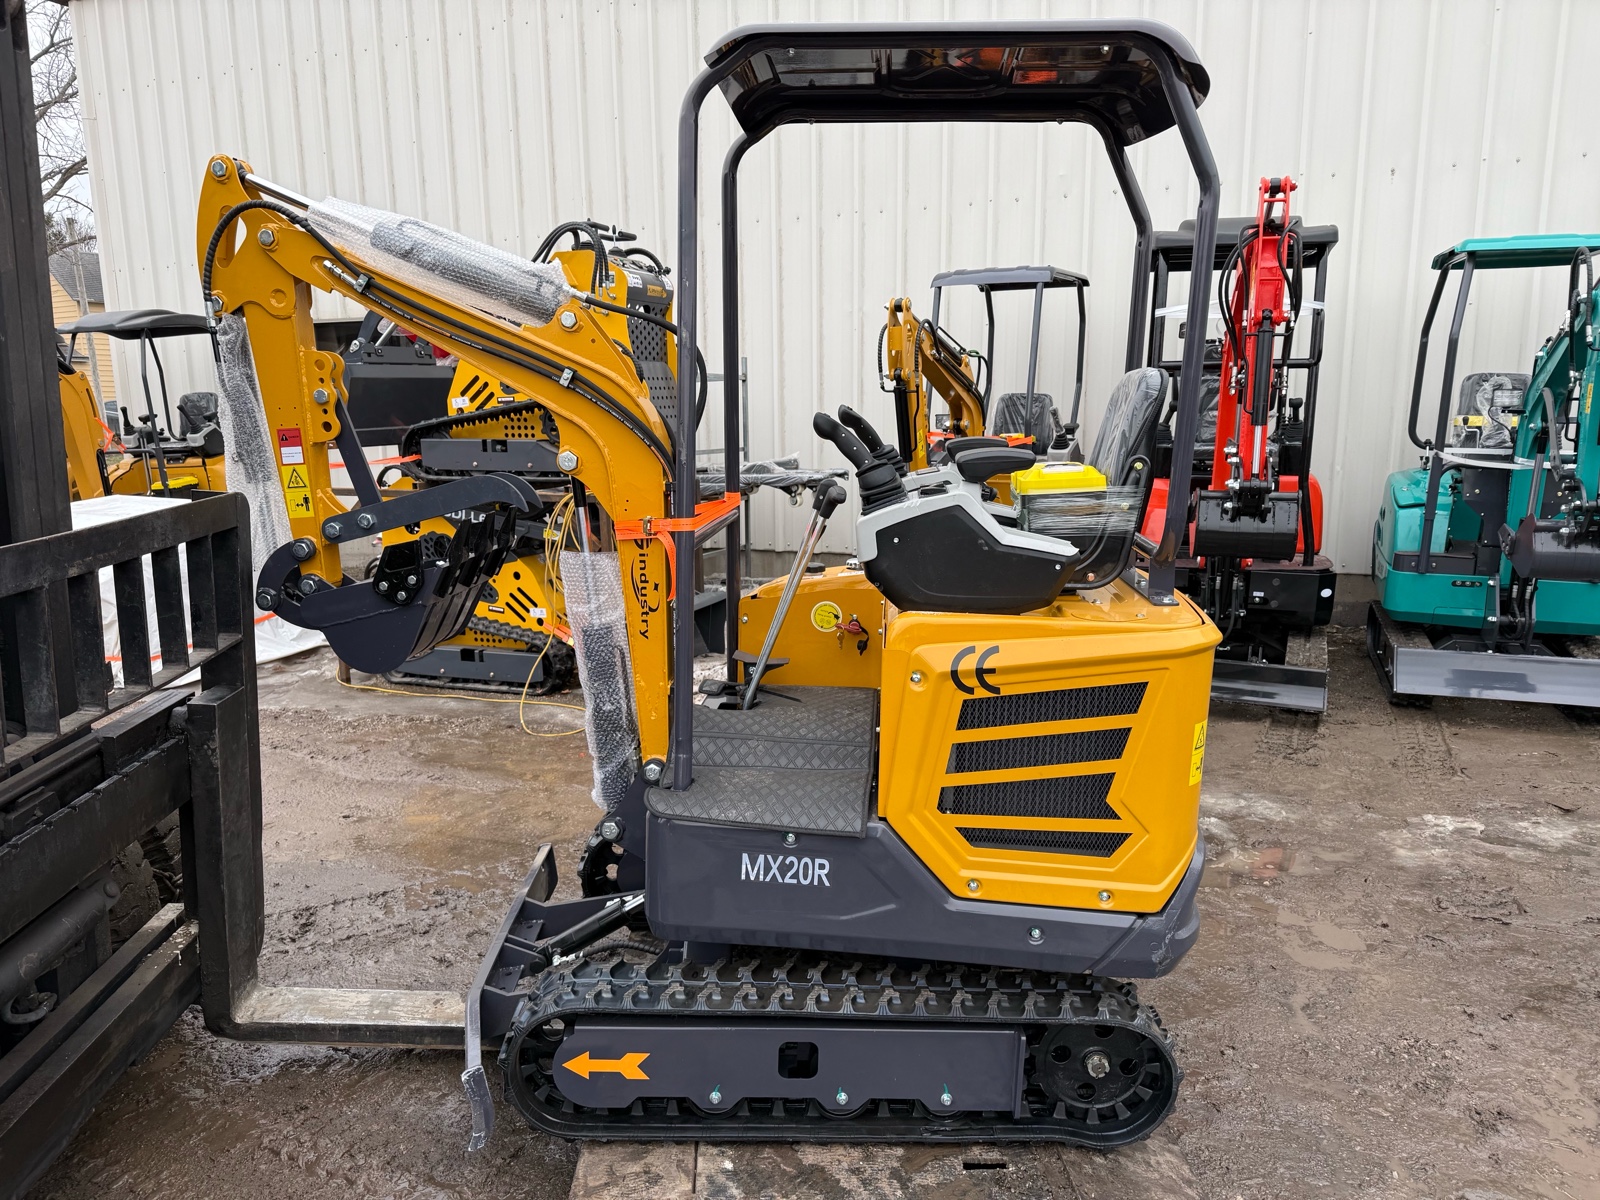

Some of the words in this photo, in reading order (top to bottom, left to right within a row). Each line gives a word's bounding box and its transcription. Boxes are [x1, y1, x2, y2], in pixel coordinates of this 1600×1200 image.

[638, 553, 650, 640] industry
[950, 645, 1001, 696] CE
[741, 853, 831, 887] MX20R
